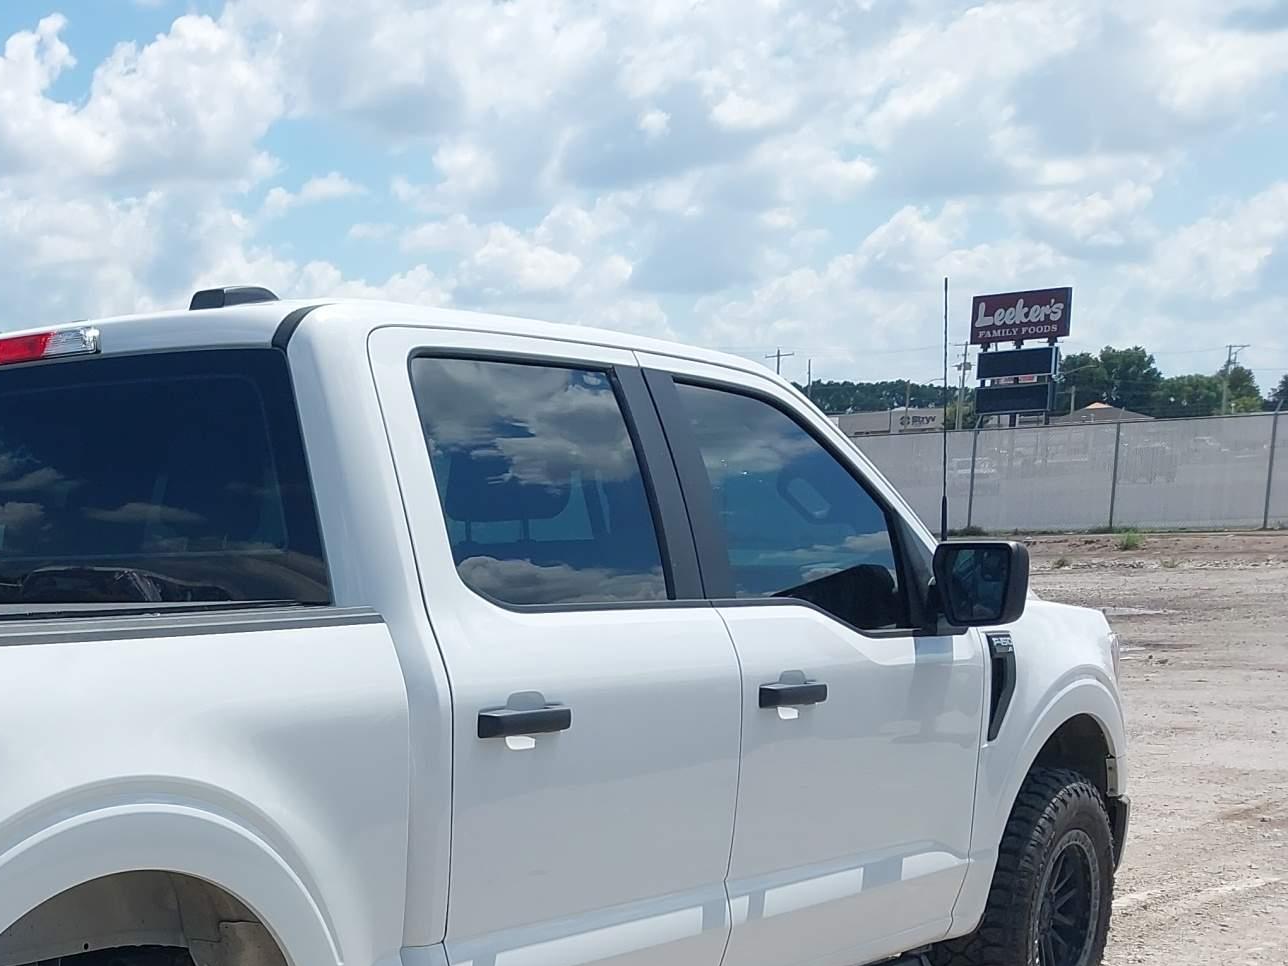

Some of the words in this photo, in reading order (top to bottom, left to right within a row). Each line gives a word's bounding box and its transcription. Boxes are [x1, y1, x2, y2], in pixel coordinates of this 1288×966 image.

[975, 299, 1064, 327] Leeker's
[978, 328, 1018, 338] FAMILY
[1021, 324, 1058, 335] FOODS
